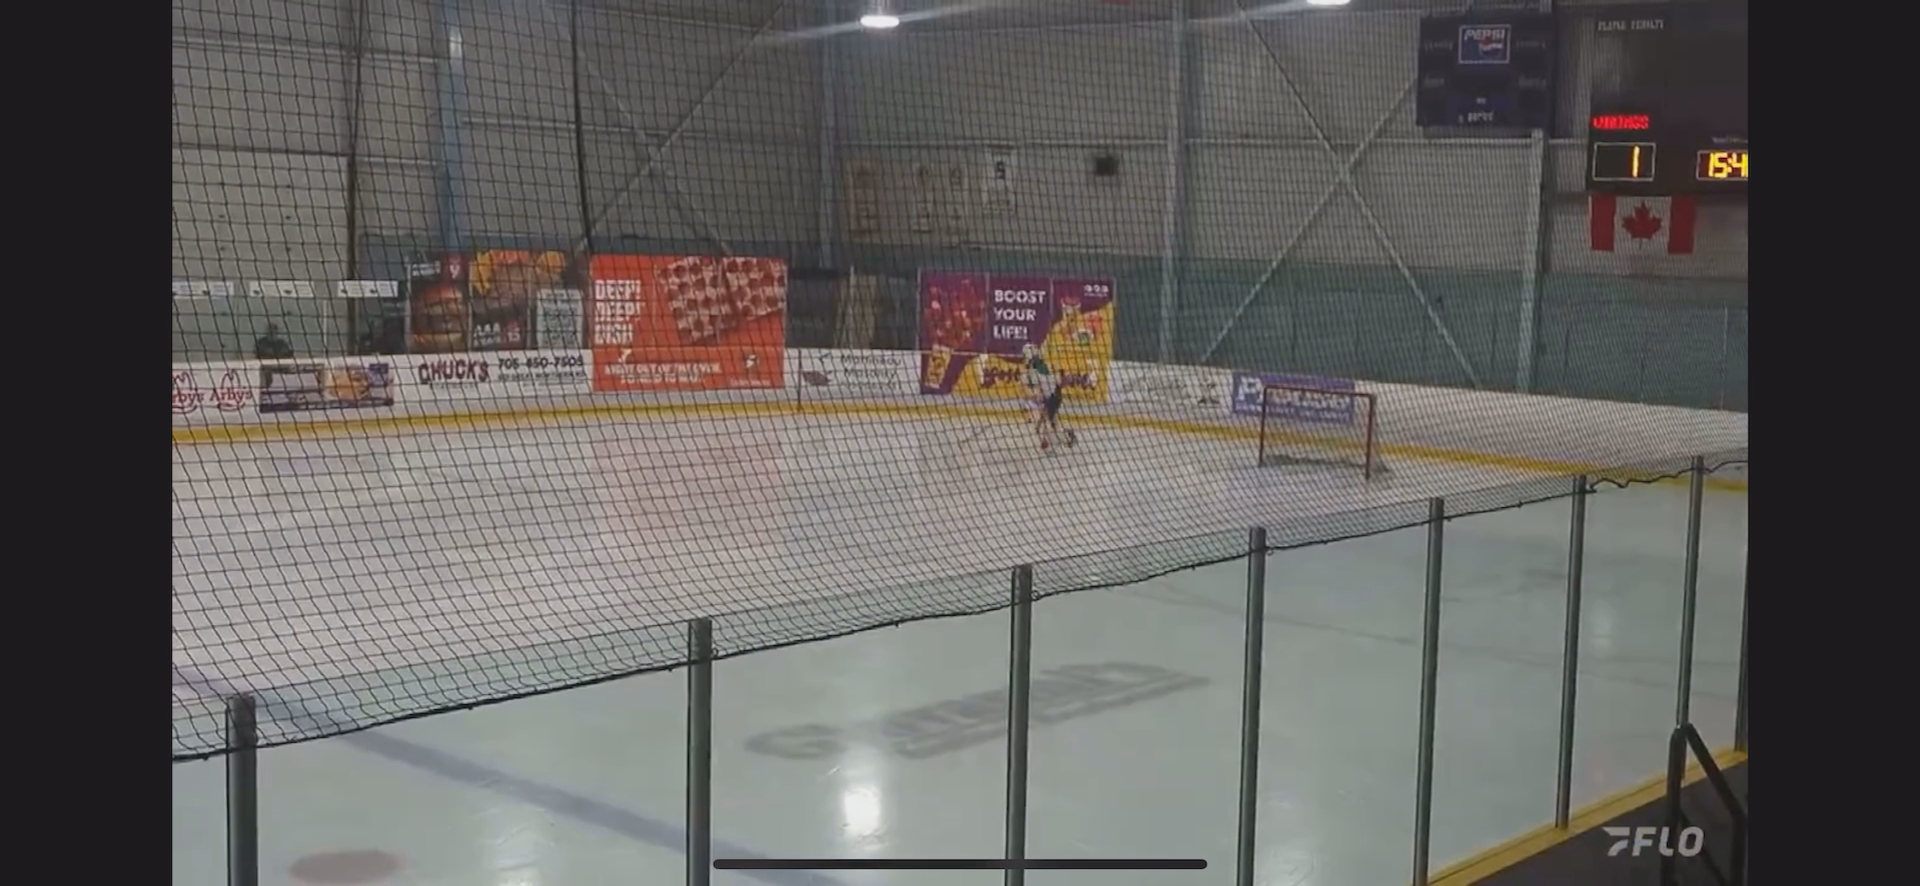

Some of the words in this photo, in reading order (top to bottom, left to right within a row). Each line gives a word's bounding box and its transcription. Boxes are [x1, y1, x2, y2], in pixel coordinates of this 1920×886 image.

[1464, 28, 1505, 40] PEPSI
[1632, 146, 1640, 178] 1
[994, 289, 1046, 304] BOOST
[993, 307, 1036, 321] YOUR
[993, 325, 1028, 340] LIFE!
